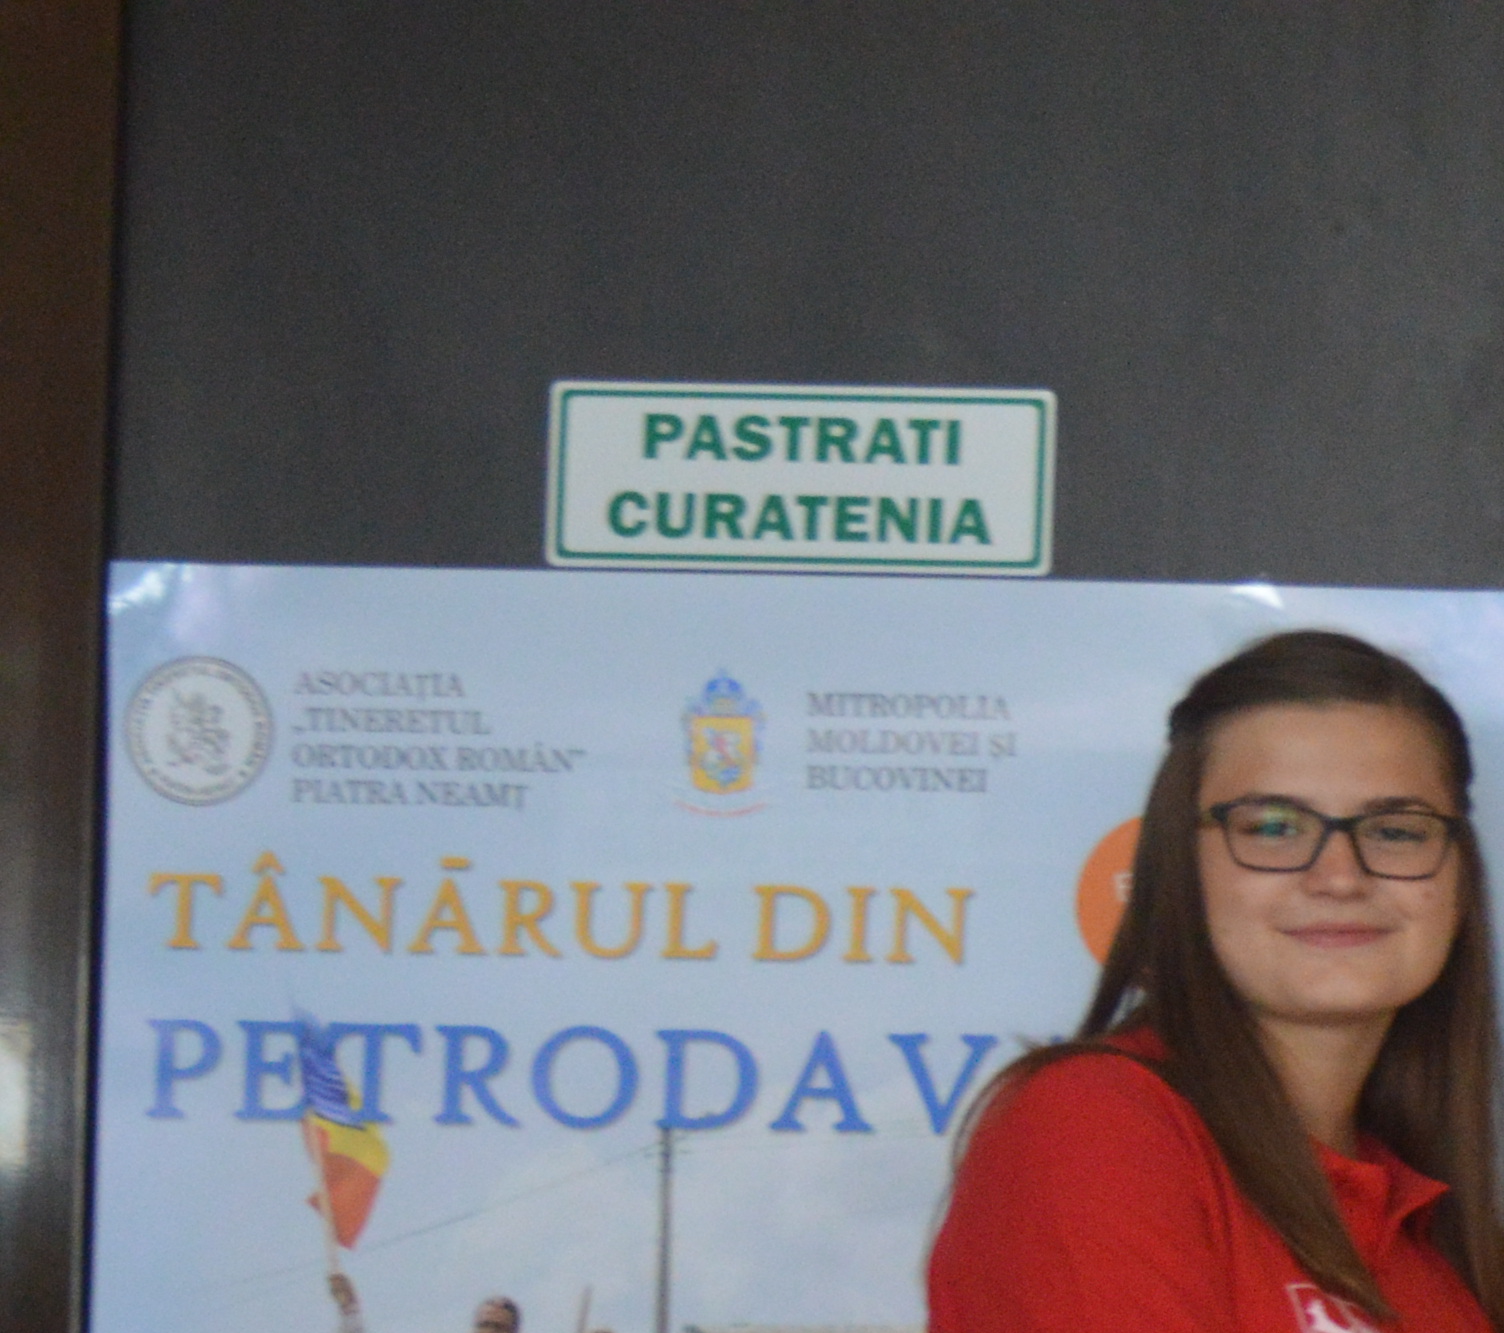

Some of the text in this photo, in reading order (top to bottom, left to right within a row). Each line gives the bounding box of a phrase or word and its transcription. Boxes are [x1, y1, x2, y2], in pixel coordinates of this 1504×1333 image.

[641, 413, 962, 467] PASTRATI
[606, 489, 992, 546] CURATENIA
[806, 691, 1013, 722] MITROPOLIA
[806, 729, 982, 757] MOLDOVEI
[291, 778, 407, 805] PIATRA
[806, 764, 988, 794] BUCOVINEI
[752, 883, 975, 966] DIN
[146, 1017, 1072, 1136] PETRODAV
